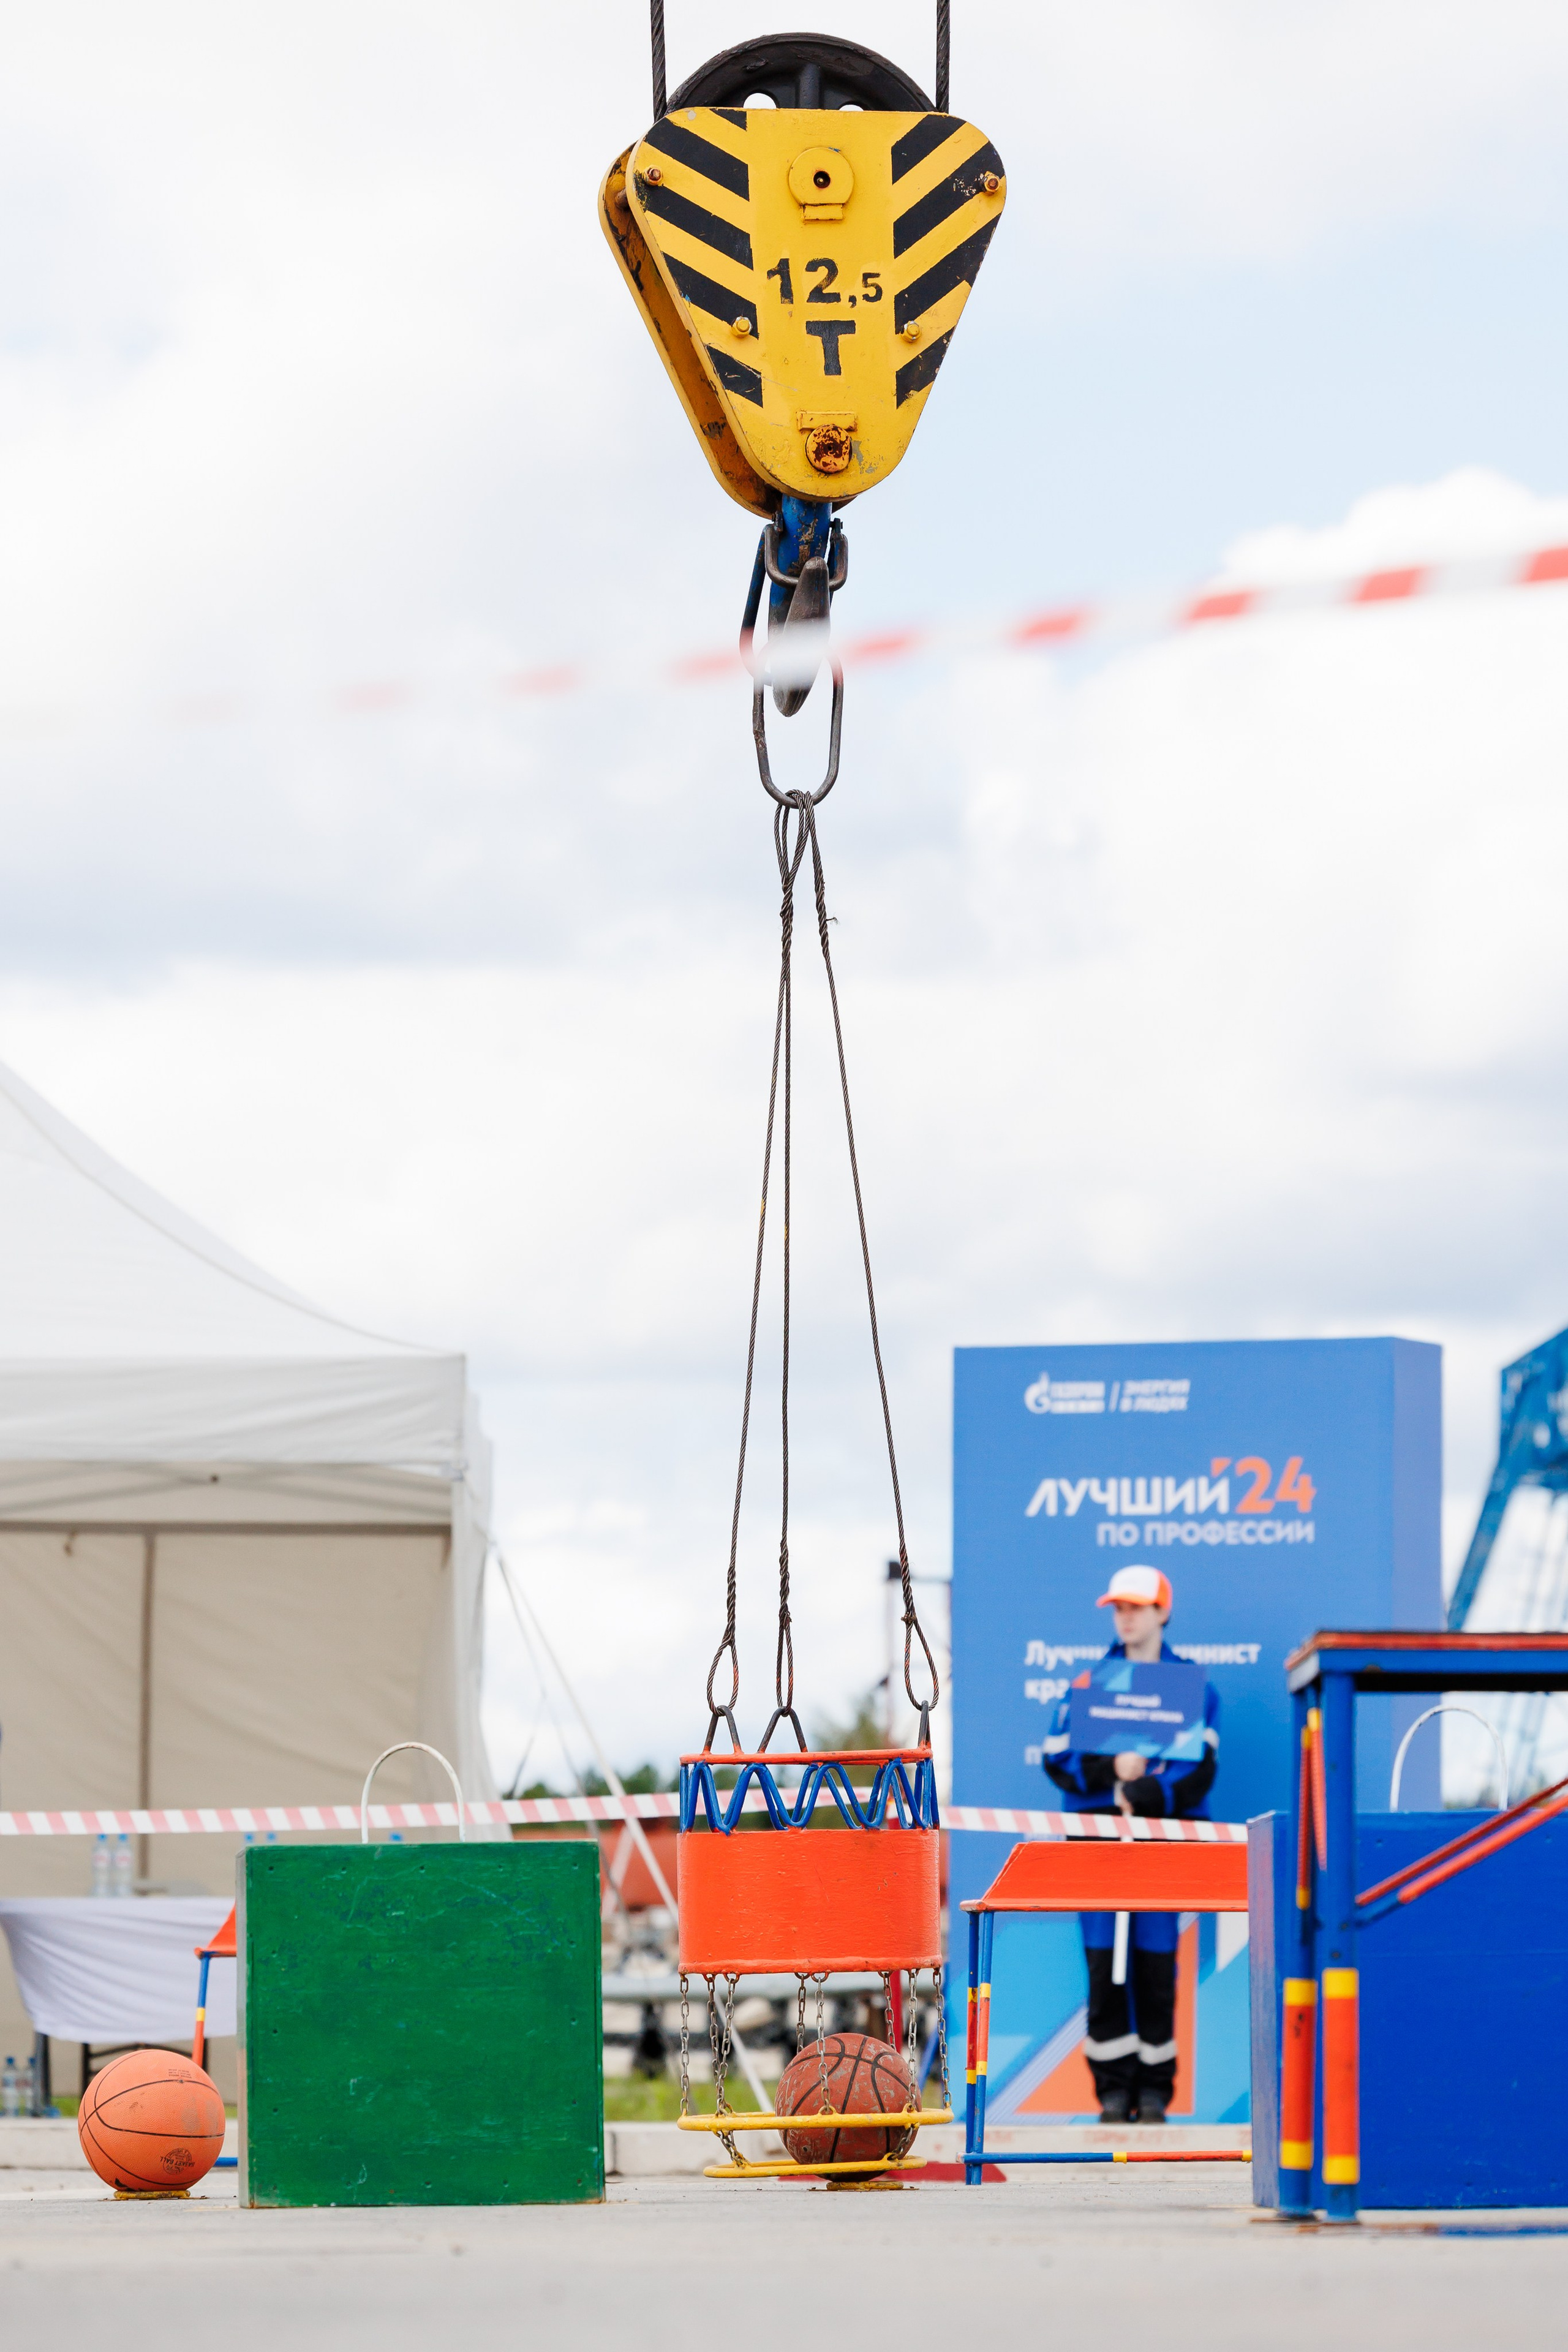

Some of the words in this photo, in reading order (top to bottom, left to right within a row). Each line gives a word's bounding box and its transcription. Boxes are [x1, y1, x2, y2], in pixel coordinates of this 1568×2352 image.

[767, 258, 883, 308] 12,5
[1097, 1521, 1139, 1547] ПО
[1145, 1520, 1314, 1546] ПРОФЕССИИ
